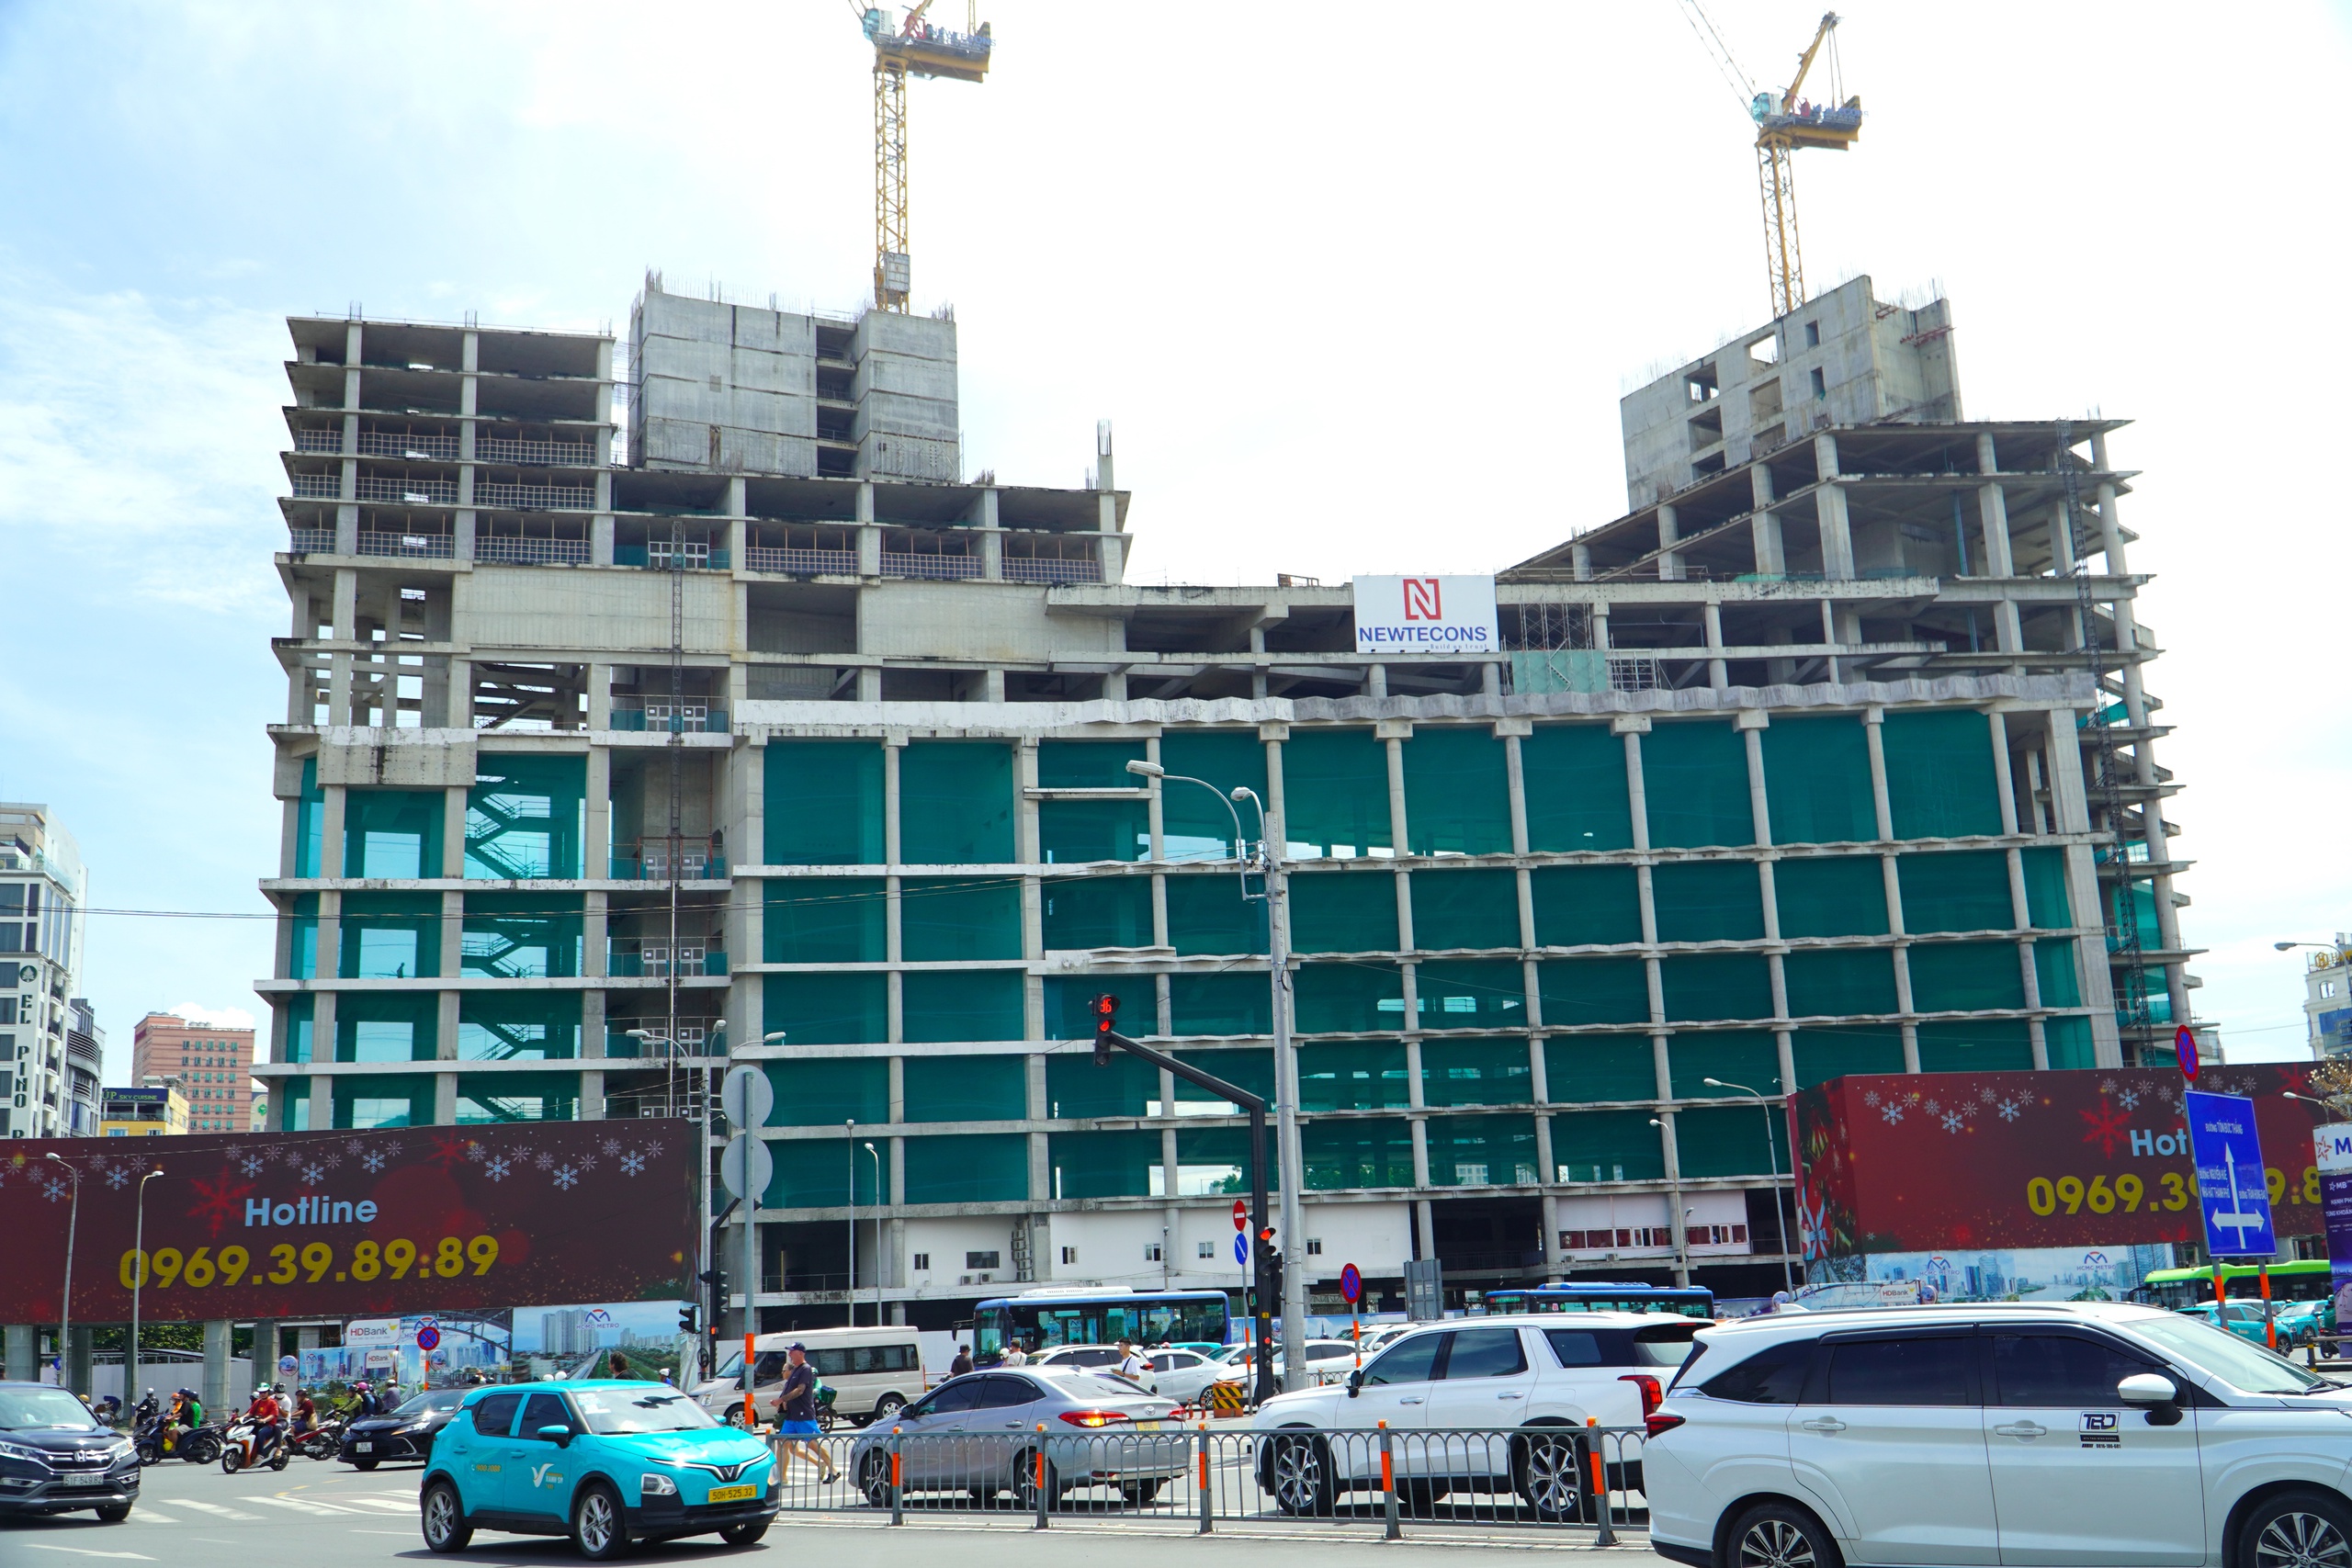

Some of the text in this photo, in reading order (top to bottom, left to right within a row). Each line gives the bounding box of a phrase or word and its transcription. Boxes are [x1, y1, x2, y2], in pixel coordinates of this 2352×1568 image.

[1359, 626, 1487, 642] NEWTECONS
[20, 994, 33, 1024] EL
[15, 1045, 30, 1108] PINO
[2335, 1136, 2352, 1156] M
[244, 1196, 378, 1227] Hotline
[119, 1235, 499, 1290] 0969.39.89.89
[350, 1327, 388, 1336] HDBank
[712, 1488, 753, 1500] 50H-525.32
